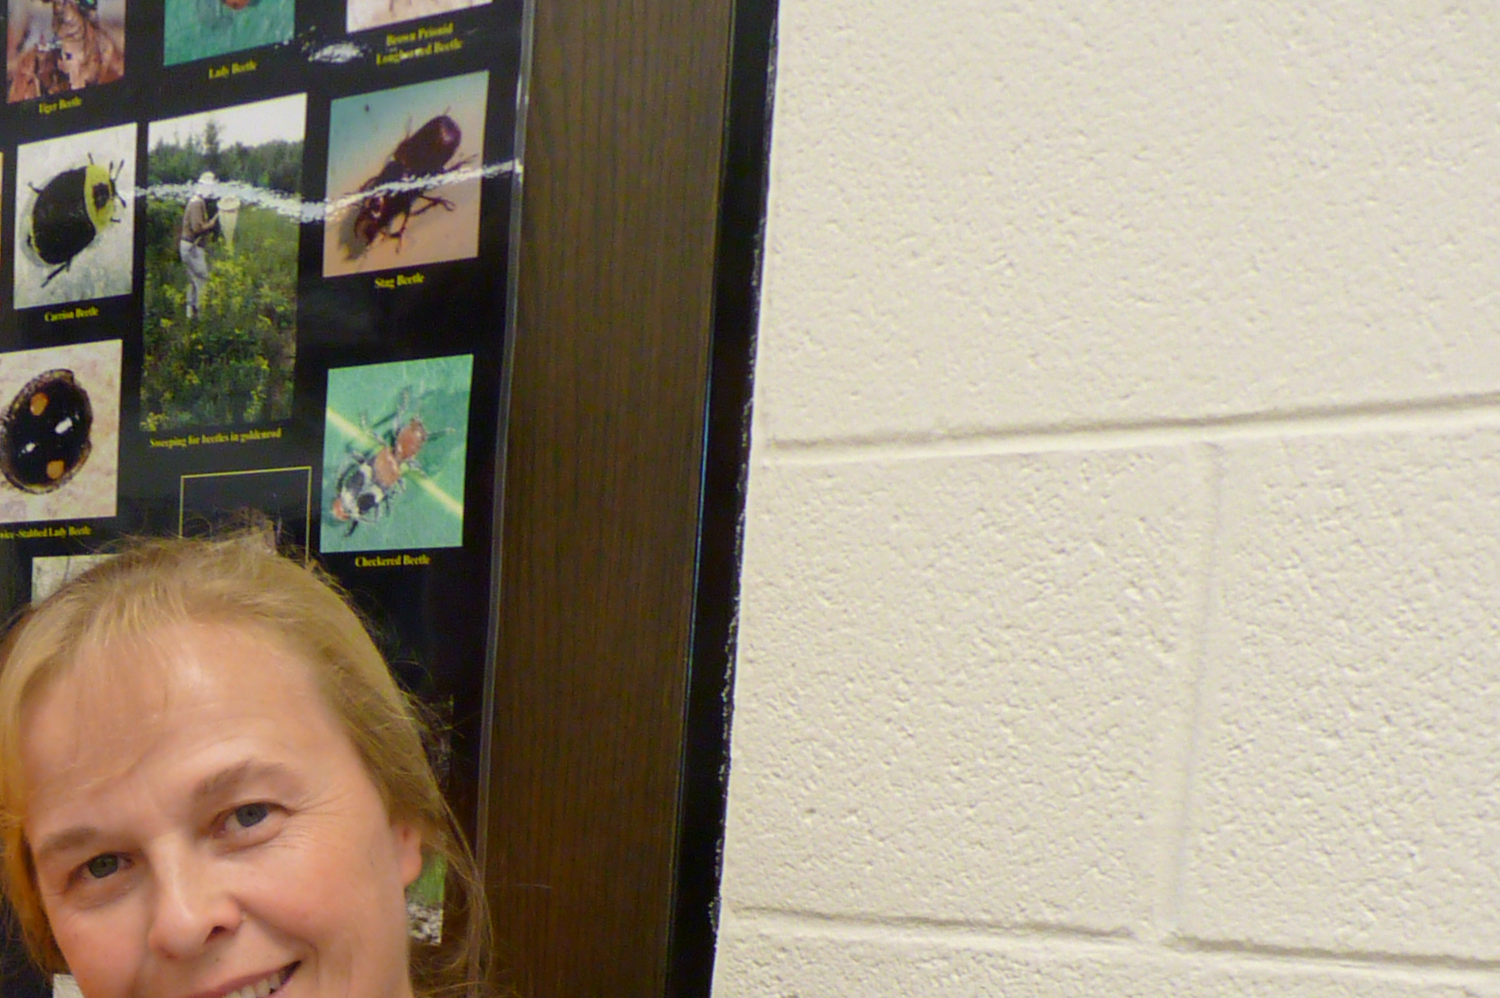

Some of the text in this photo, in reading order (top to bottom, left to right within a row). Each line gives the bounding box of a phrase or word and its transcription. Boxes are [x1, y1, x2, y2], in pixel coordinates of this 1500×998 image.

[434, 38, 462, 54] Beetle
[208, 58, 258, 79] Lady Beetle
[38, 96, 82, 115] Tiger Beetle
[375, 272, 425, 290] Stag Beetle
[44, 306, 100, 322] Carrion Beetle
[188, 434, 201, 446] for
[201, 432, 229, 445] beetles
[230, 431, 240, 443] in
[240, 427, 283, 444] goldenrod
[48, 526, 67, 539] Lady
[68, 523, 93, 537] Beetle
[355, 553, 431, 568] Checkered Beetle
